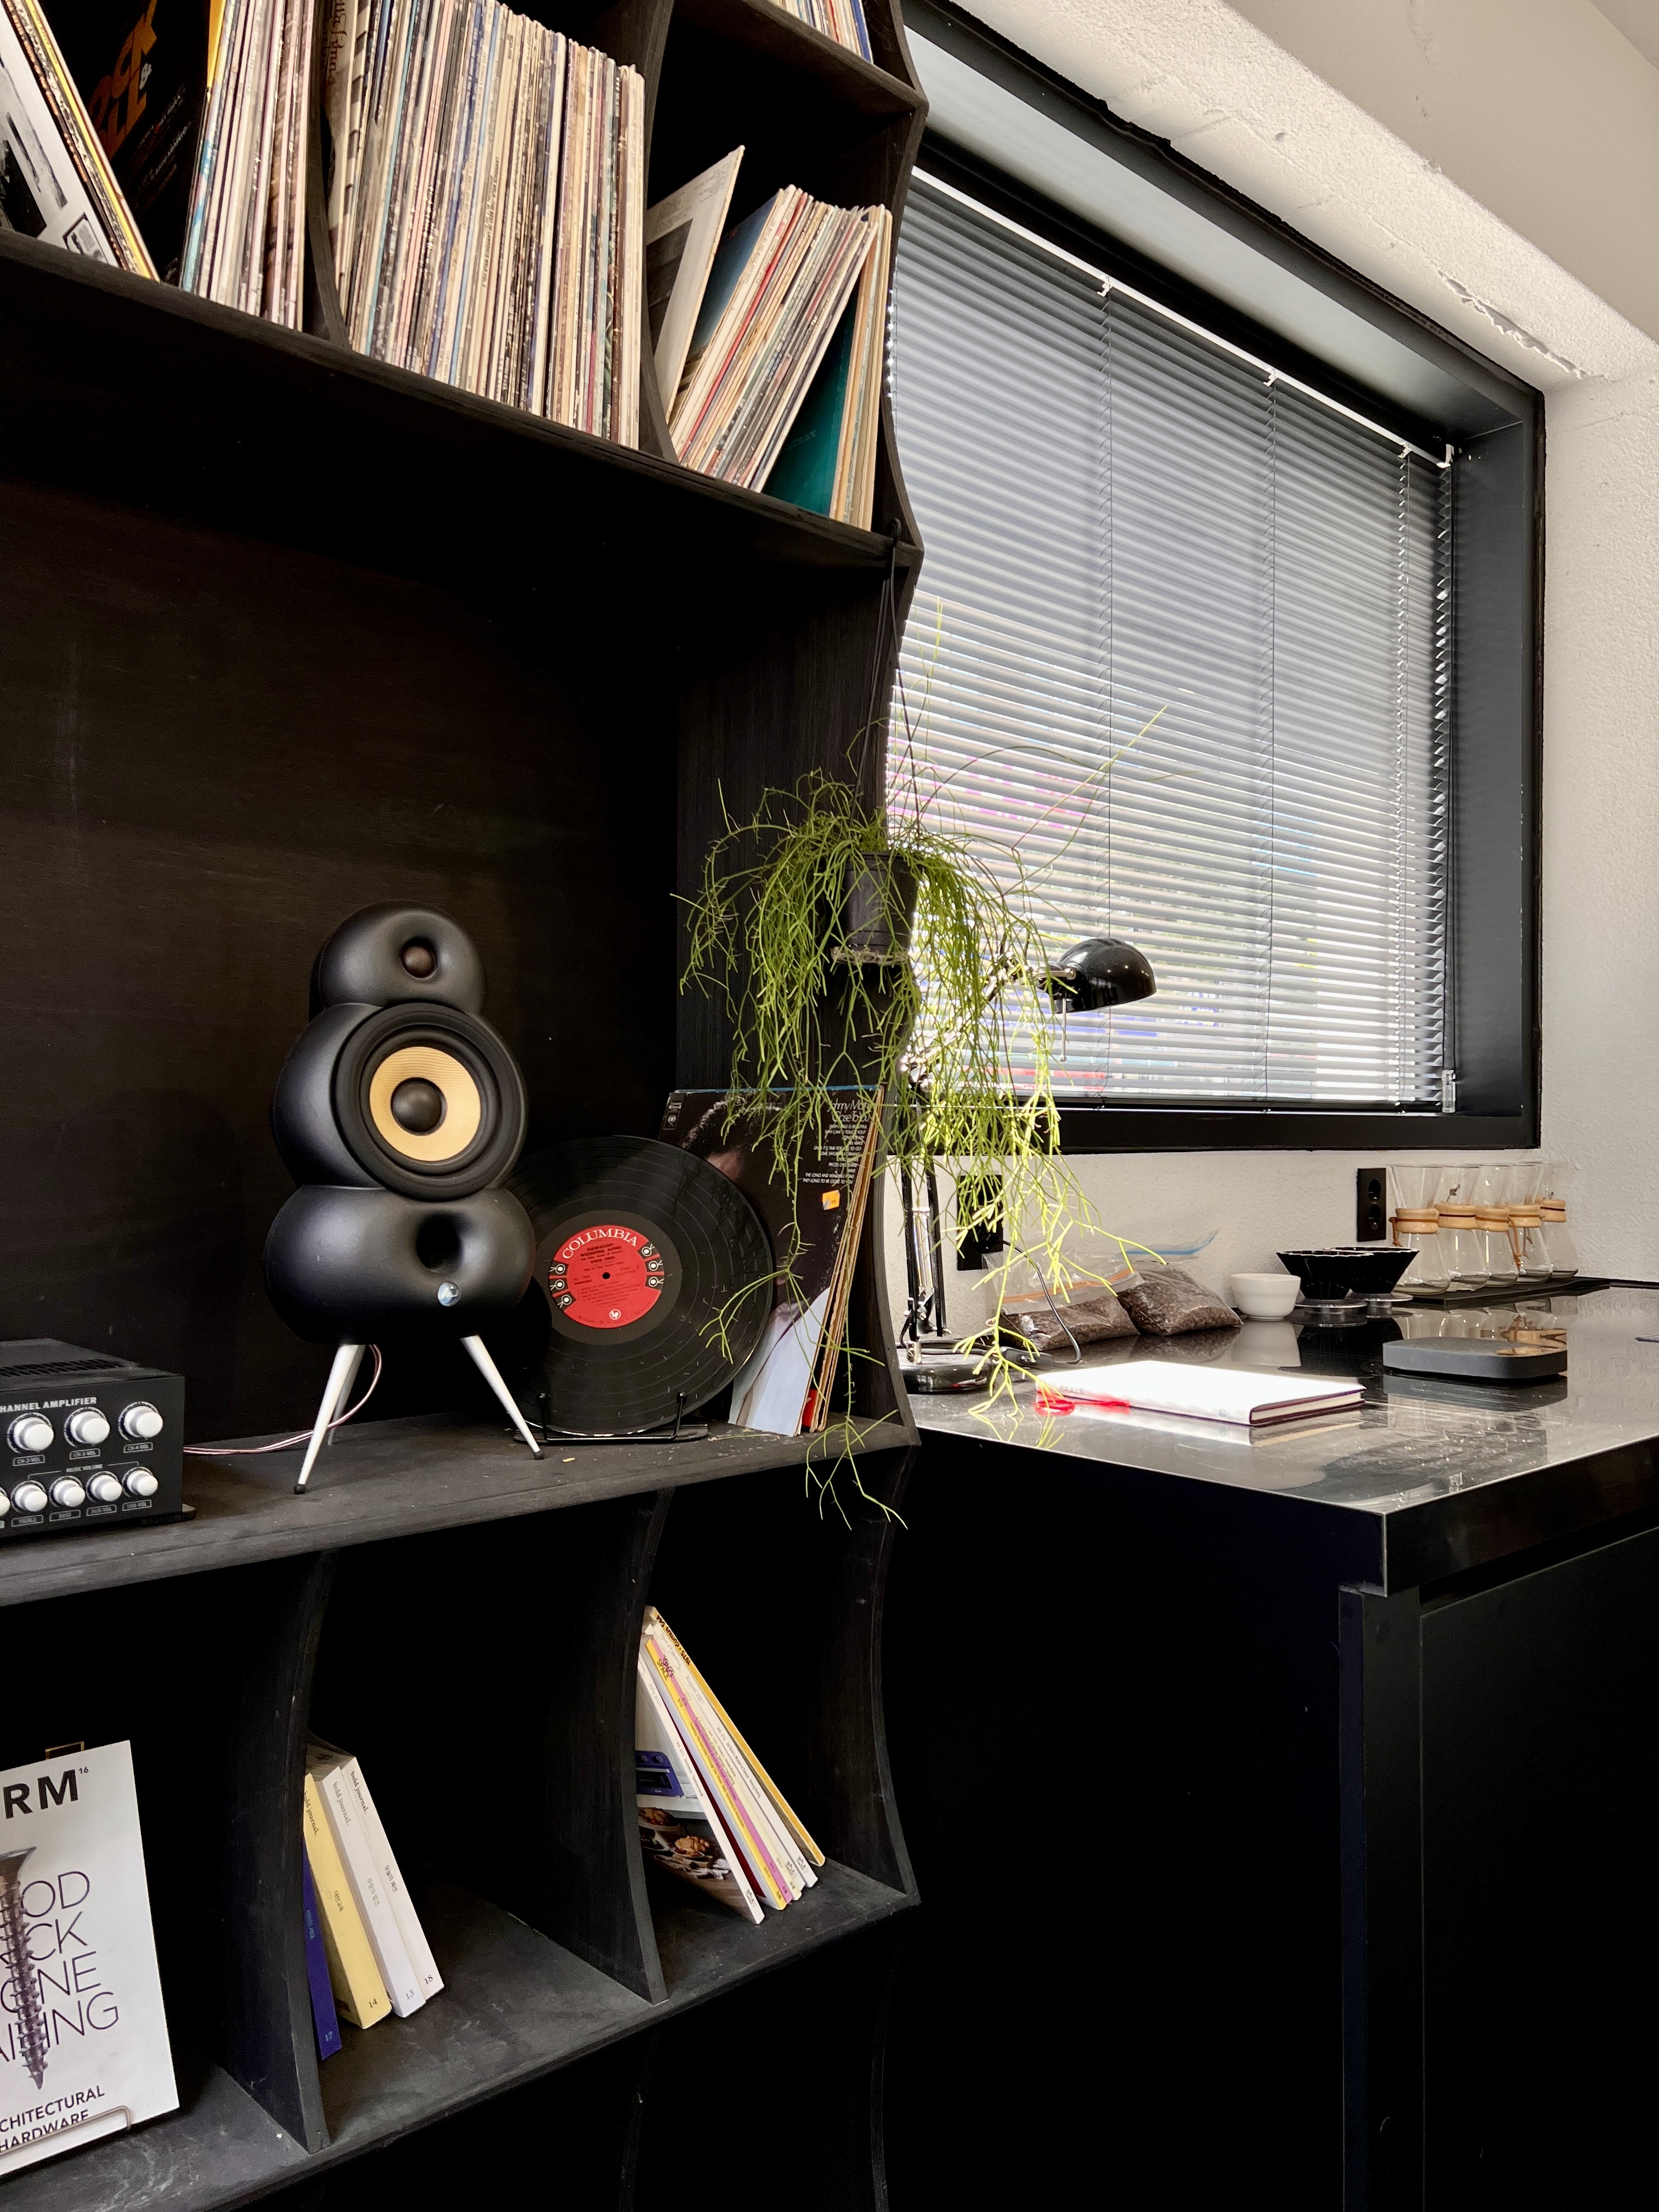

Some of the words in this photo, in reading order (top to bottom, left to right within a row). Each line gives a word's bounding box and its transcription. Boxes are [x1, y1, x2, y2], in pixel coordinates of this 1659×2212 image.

[562, 1228, 637, 1259] COLUMBIA
[43, 1397, 97, 1409] AMPLIFIER
[663, 1626, 680, 1647] domus
[679, 1650, 692, 1666] 1975
[657, 1658, 669, 1681] SPACE
[647, 1683, 656, 1694] July
[684, 1675, 698, 1693] August
[351, 1770, 359, 1787] bold
[3, 1769, 78, 1820] RM
[333, 1781, 342, 1798] bold
[354, 1786, 369, 1814] journal.
[336, 1797, 352, 1826] journal.
[307, 1807, 319, 1836] journal.
[384, 1865, 394, 1882] 오늘의
[424, 1974, 433, 1985] 18
[369, 1998, 378, 2008] 14
[405, 1989, 415, 2000] 13
[325, 2031, 333, 2041] 17
